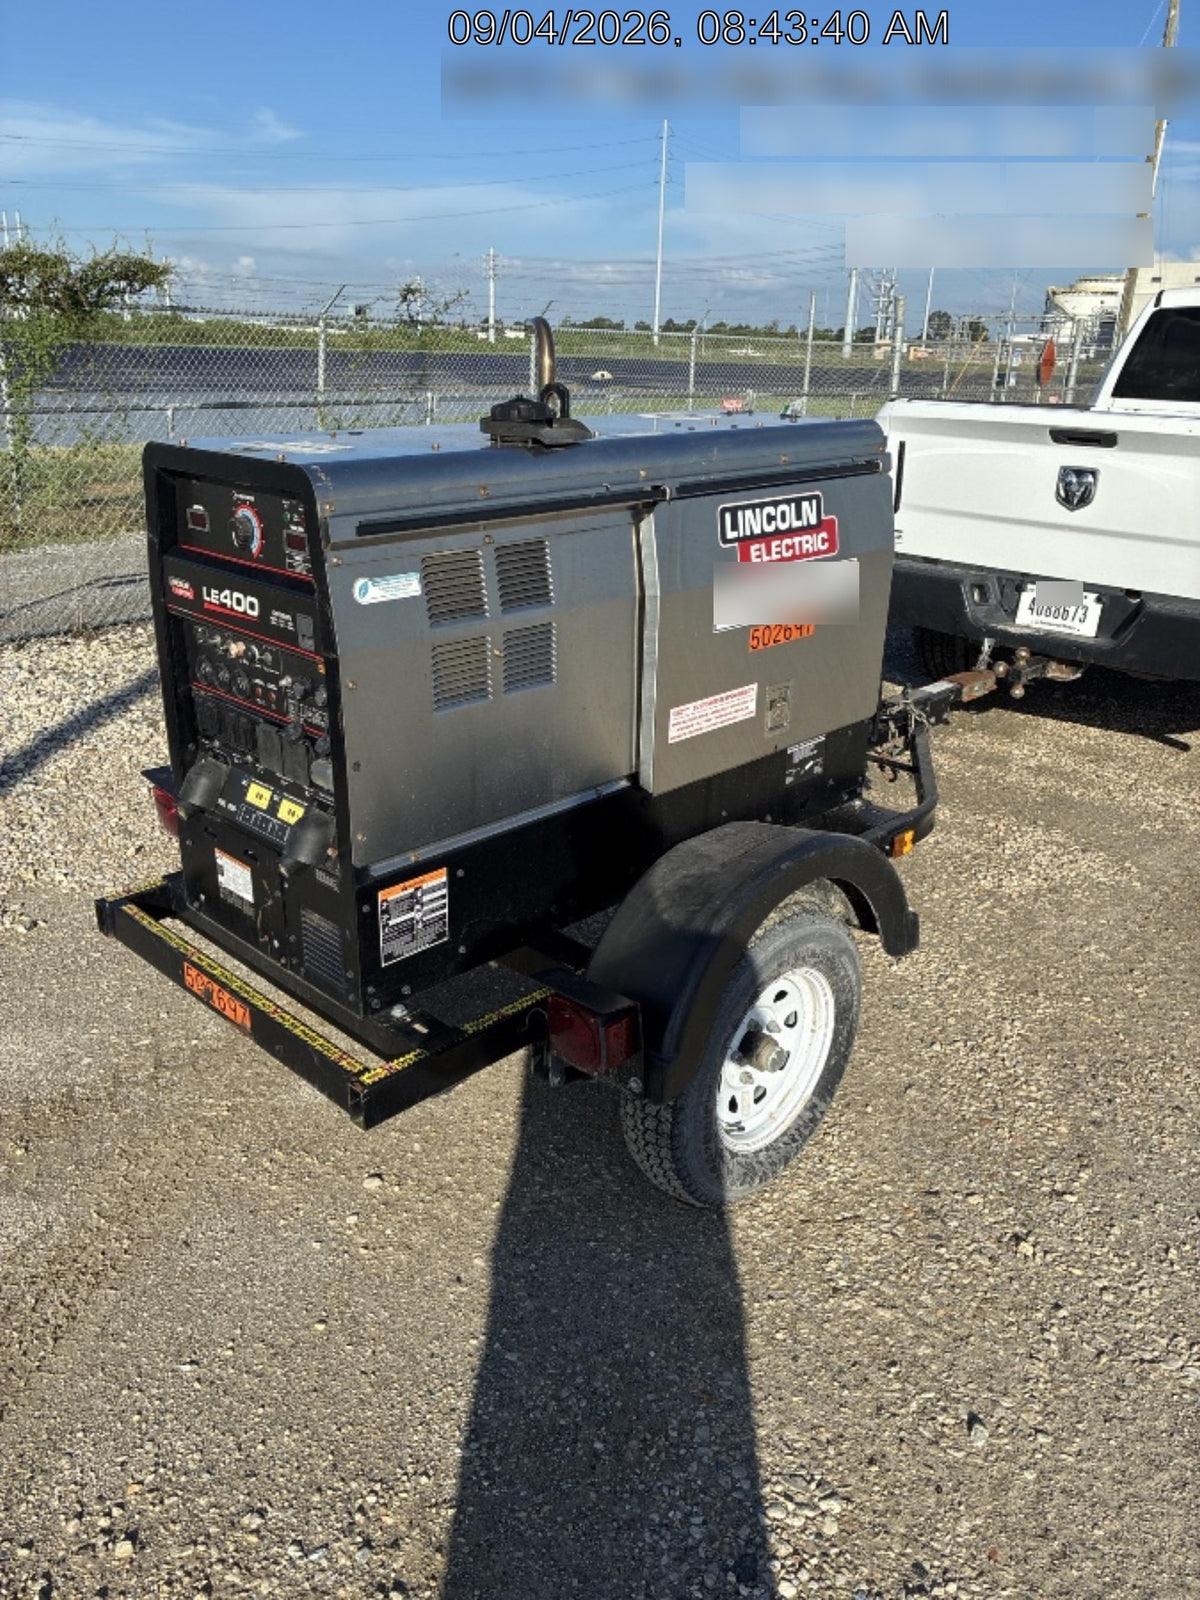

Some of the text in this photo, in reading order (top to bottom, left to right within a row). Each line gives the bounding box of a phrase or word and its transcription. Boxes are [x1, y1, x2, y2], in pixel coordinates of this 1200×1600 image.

[725, 499, 818, 539] LINCOLN
[750, 531, 829, 563] ELECTRIC
[202, 586, 259, 617] LE400
